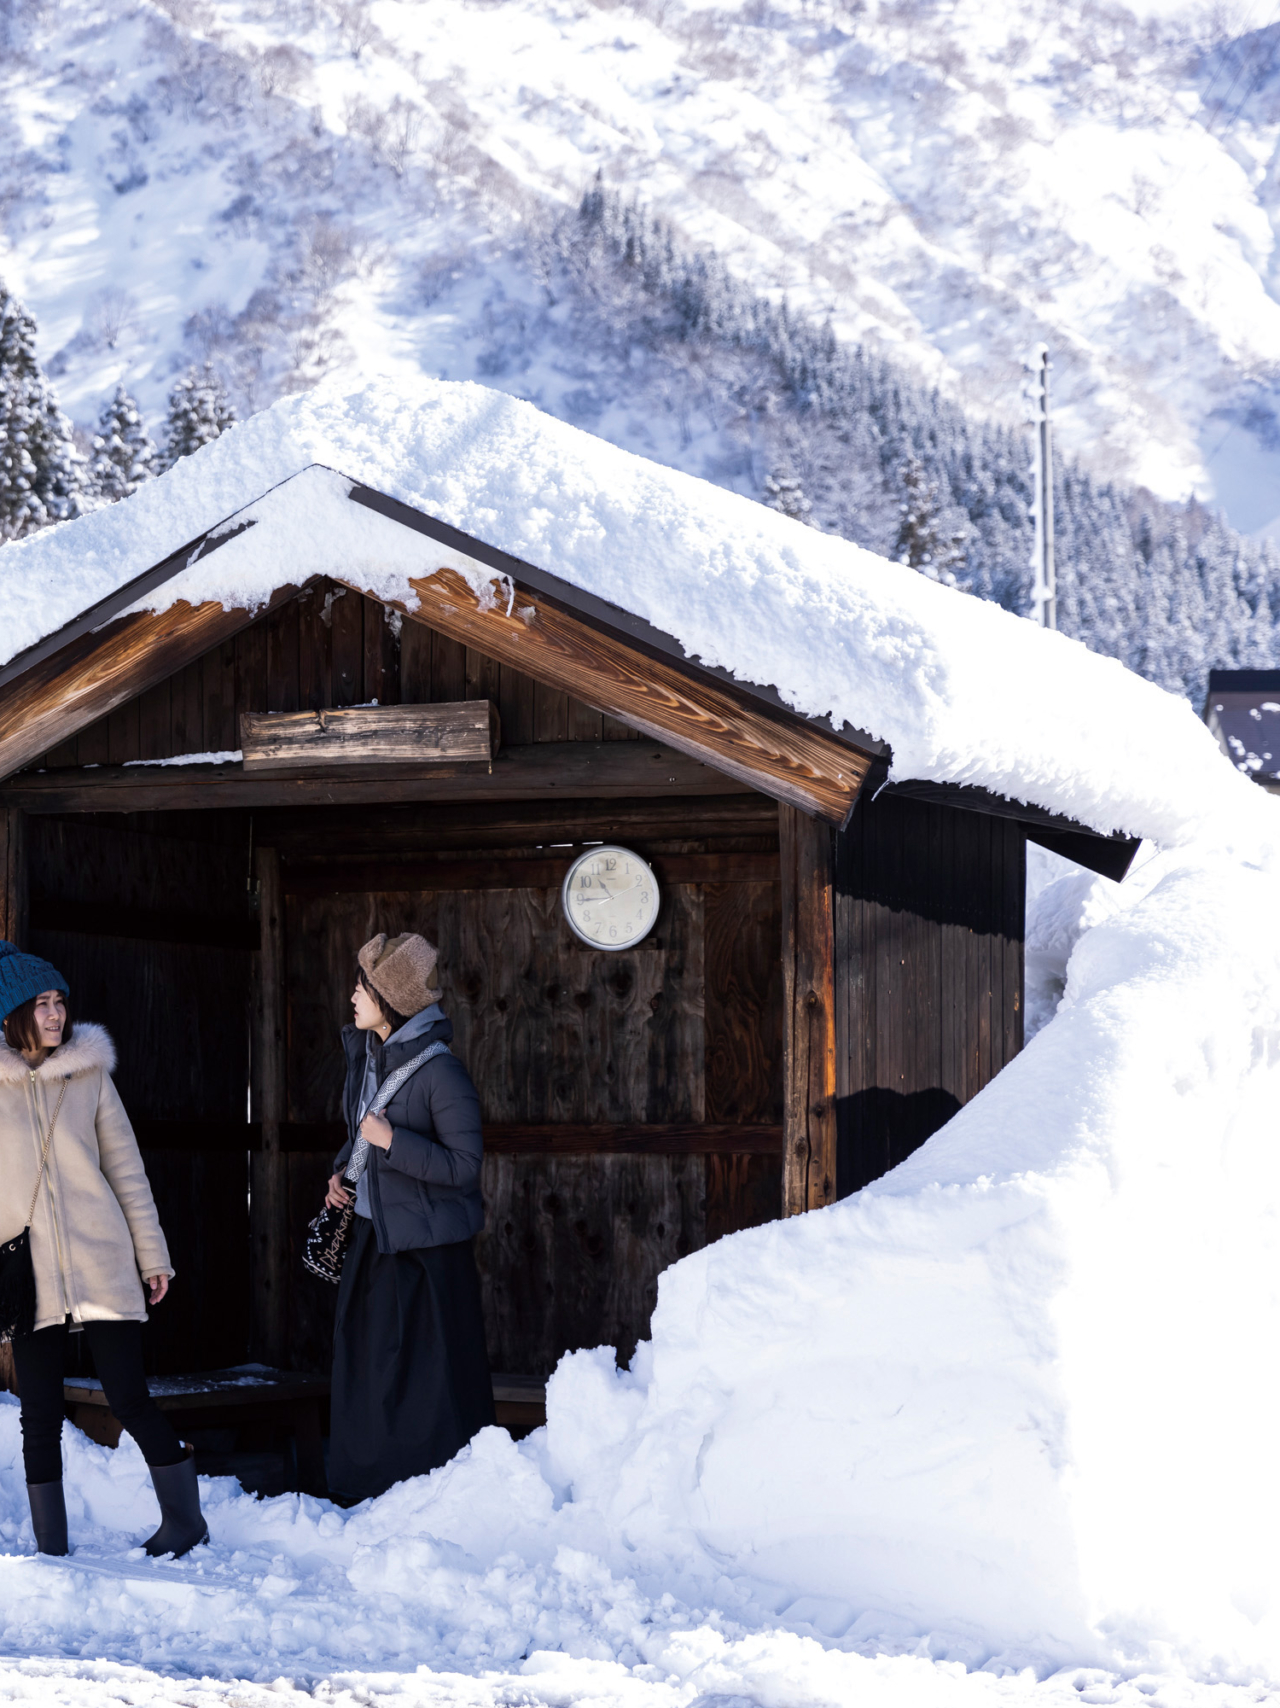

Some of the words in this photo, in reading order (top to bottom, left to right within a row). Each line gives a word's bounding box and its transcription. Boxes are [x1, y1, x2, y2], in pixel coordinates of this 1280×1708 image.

[591, 863, 601, 876] 11
[605, 858, 617, 871] 12
[580, 875, 592, 888] 10
[635, 874, 643, 887] 2
[576, 893, 585, 906] 9
[640, 891, 649, 904] 3
[583, 909, 591, 922] 8
[635, 908, 643, 920] 4
[594, 922, 602, 934] 7
[609, 925, 617, 938] 6
[625, 922, 633, 933] 5
